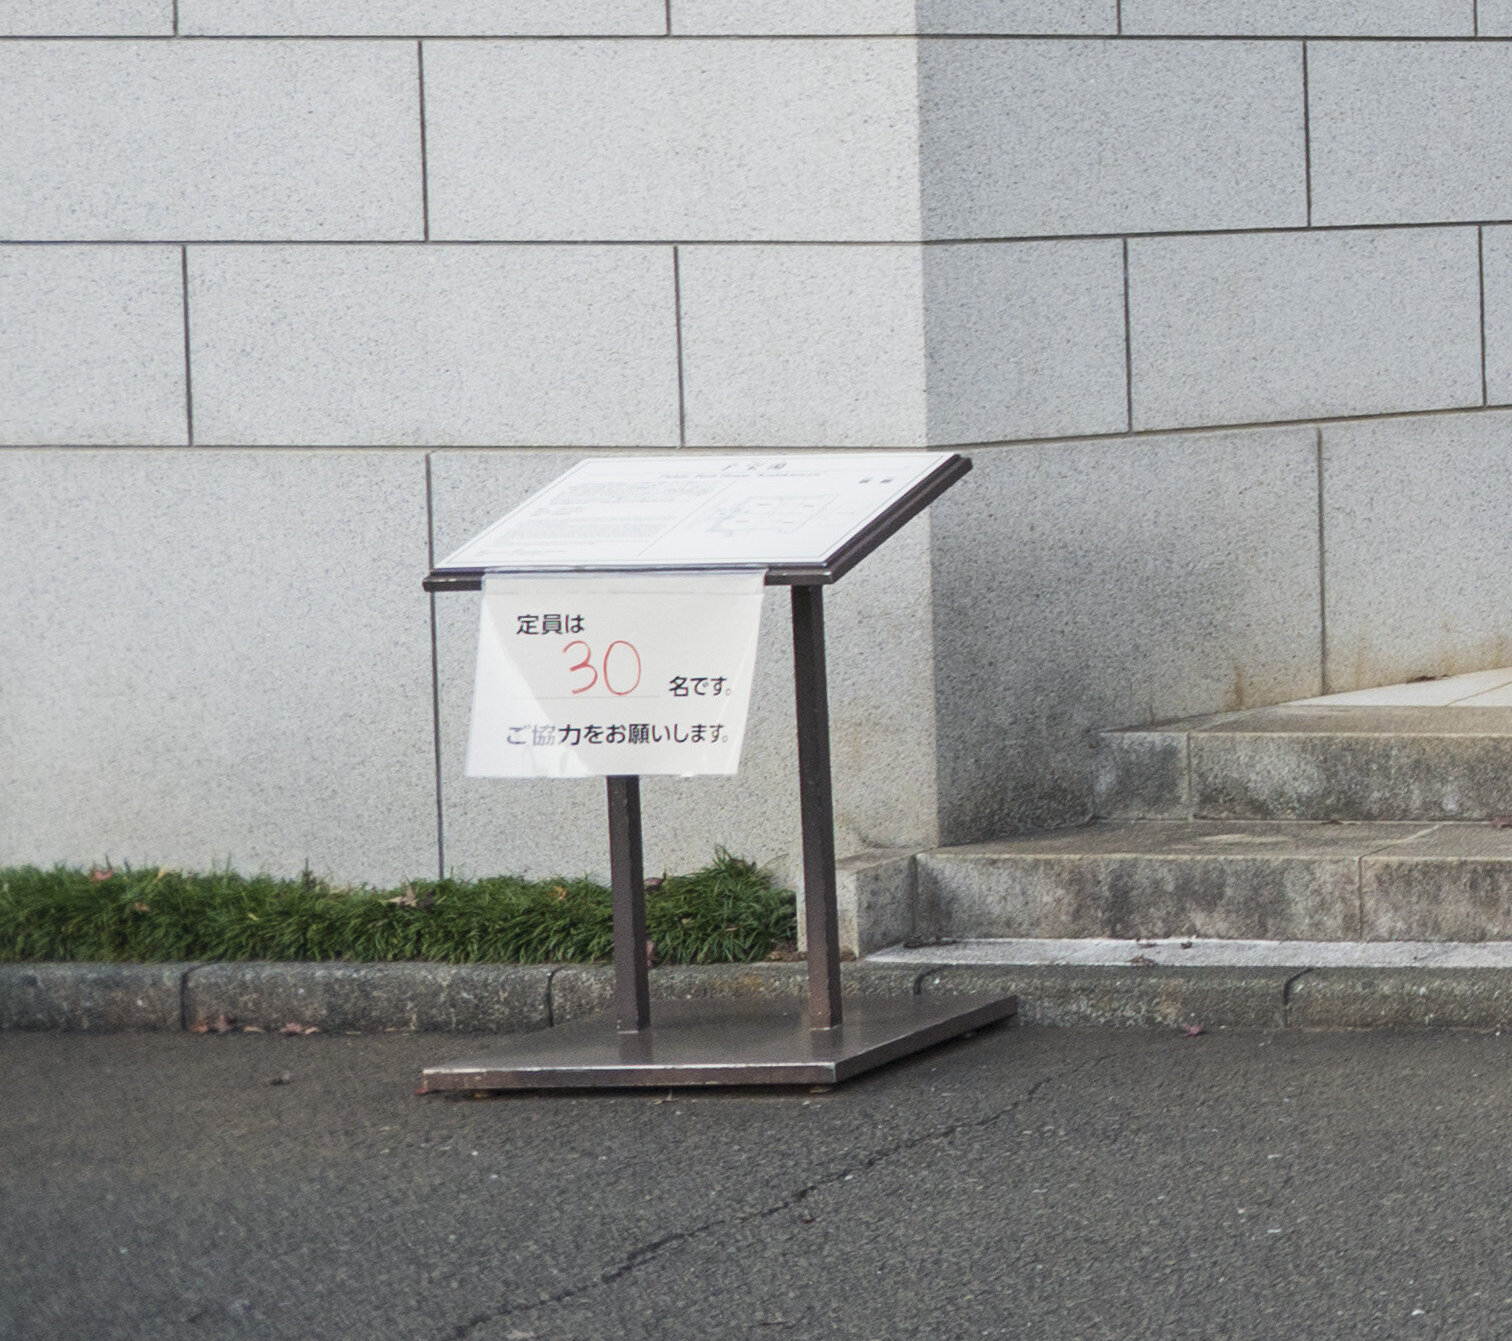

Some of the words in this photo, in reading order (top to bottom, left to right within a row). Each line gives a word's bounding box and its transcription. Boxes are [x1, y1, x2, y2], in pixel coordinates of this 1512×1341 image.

[516, 614, 585, 635] 定員は
[562, 640, 642, 696] 30
[668, 675, 732, 698] 名です。
[506, 723, 729, 747] ご協力をお願いします。
